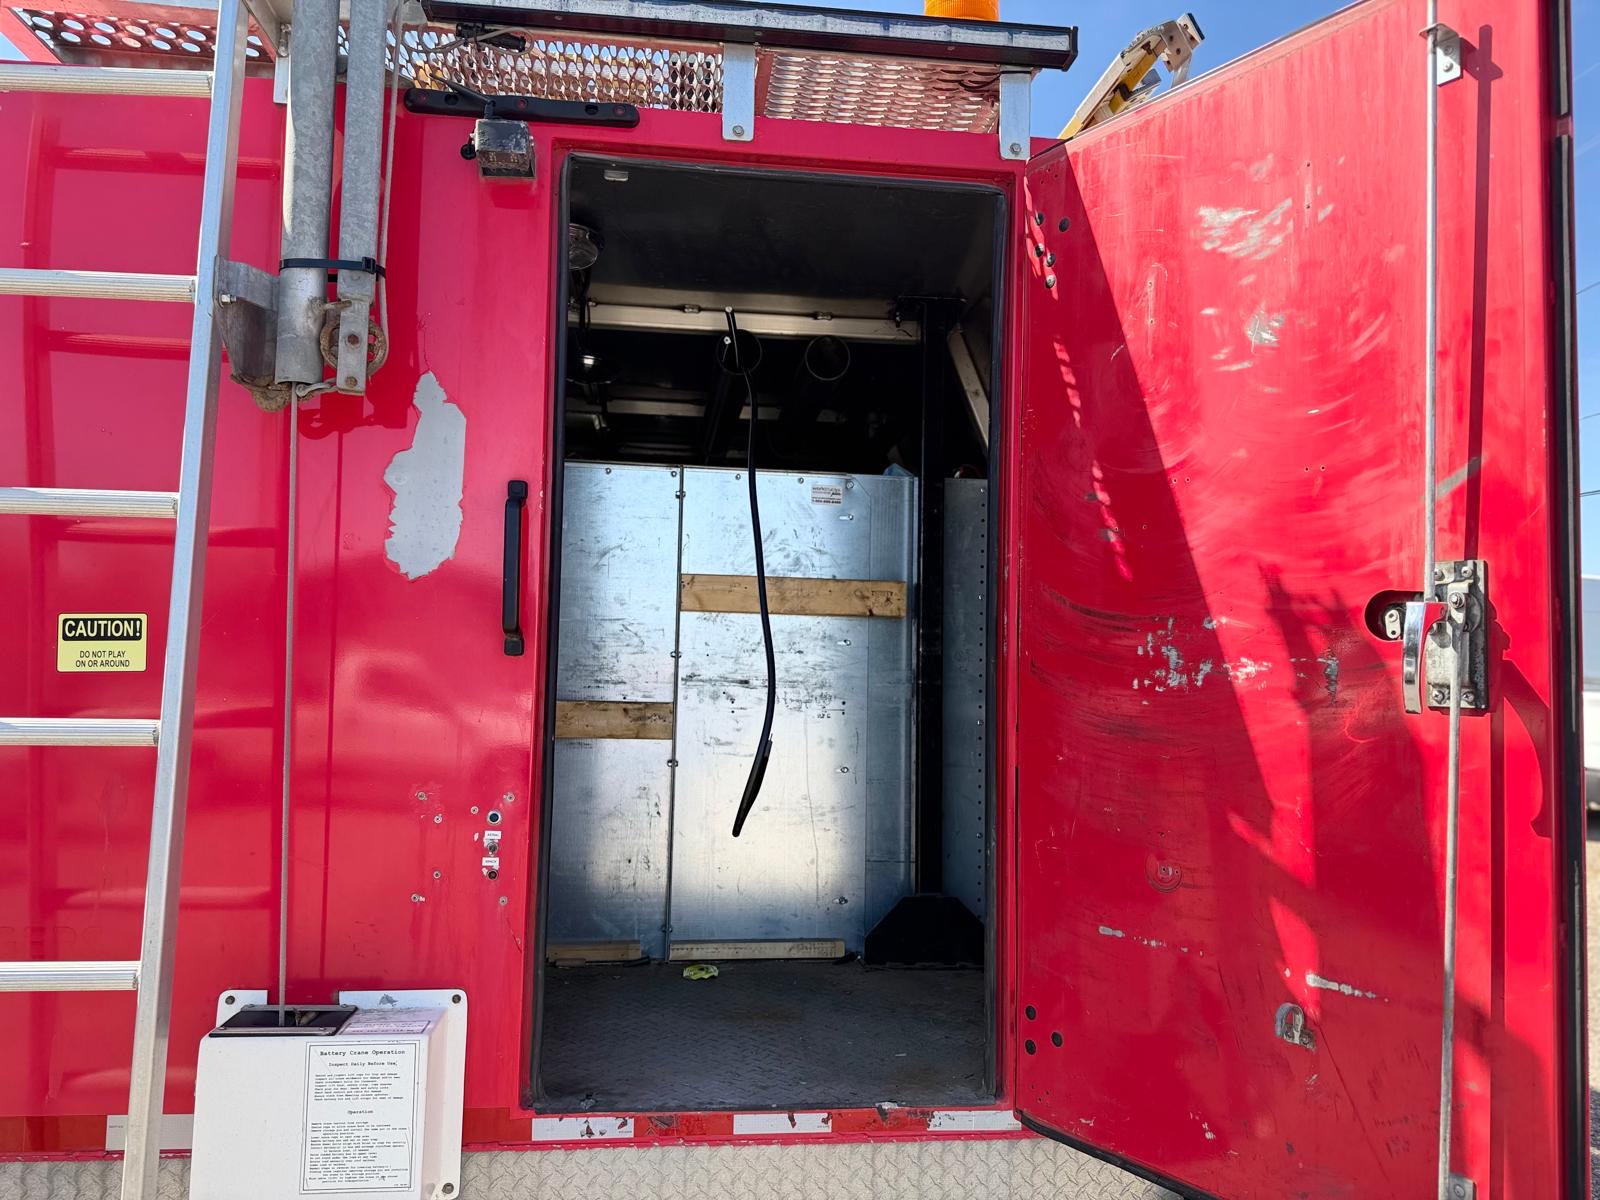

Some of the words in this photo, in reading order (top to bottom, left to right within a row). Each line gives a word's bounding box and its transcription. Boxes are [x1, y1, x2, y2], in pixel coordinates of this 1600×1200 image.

[64, 620, 141, 637] CAUTION!
[79, 650, 90, 658] DO
[92, 650, 107, 658] NOT
[108, 650, 126, 658] PLAY
